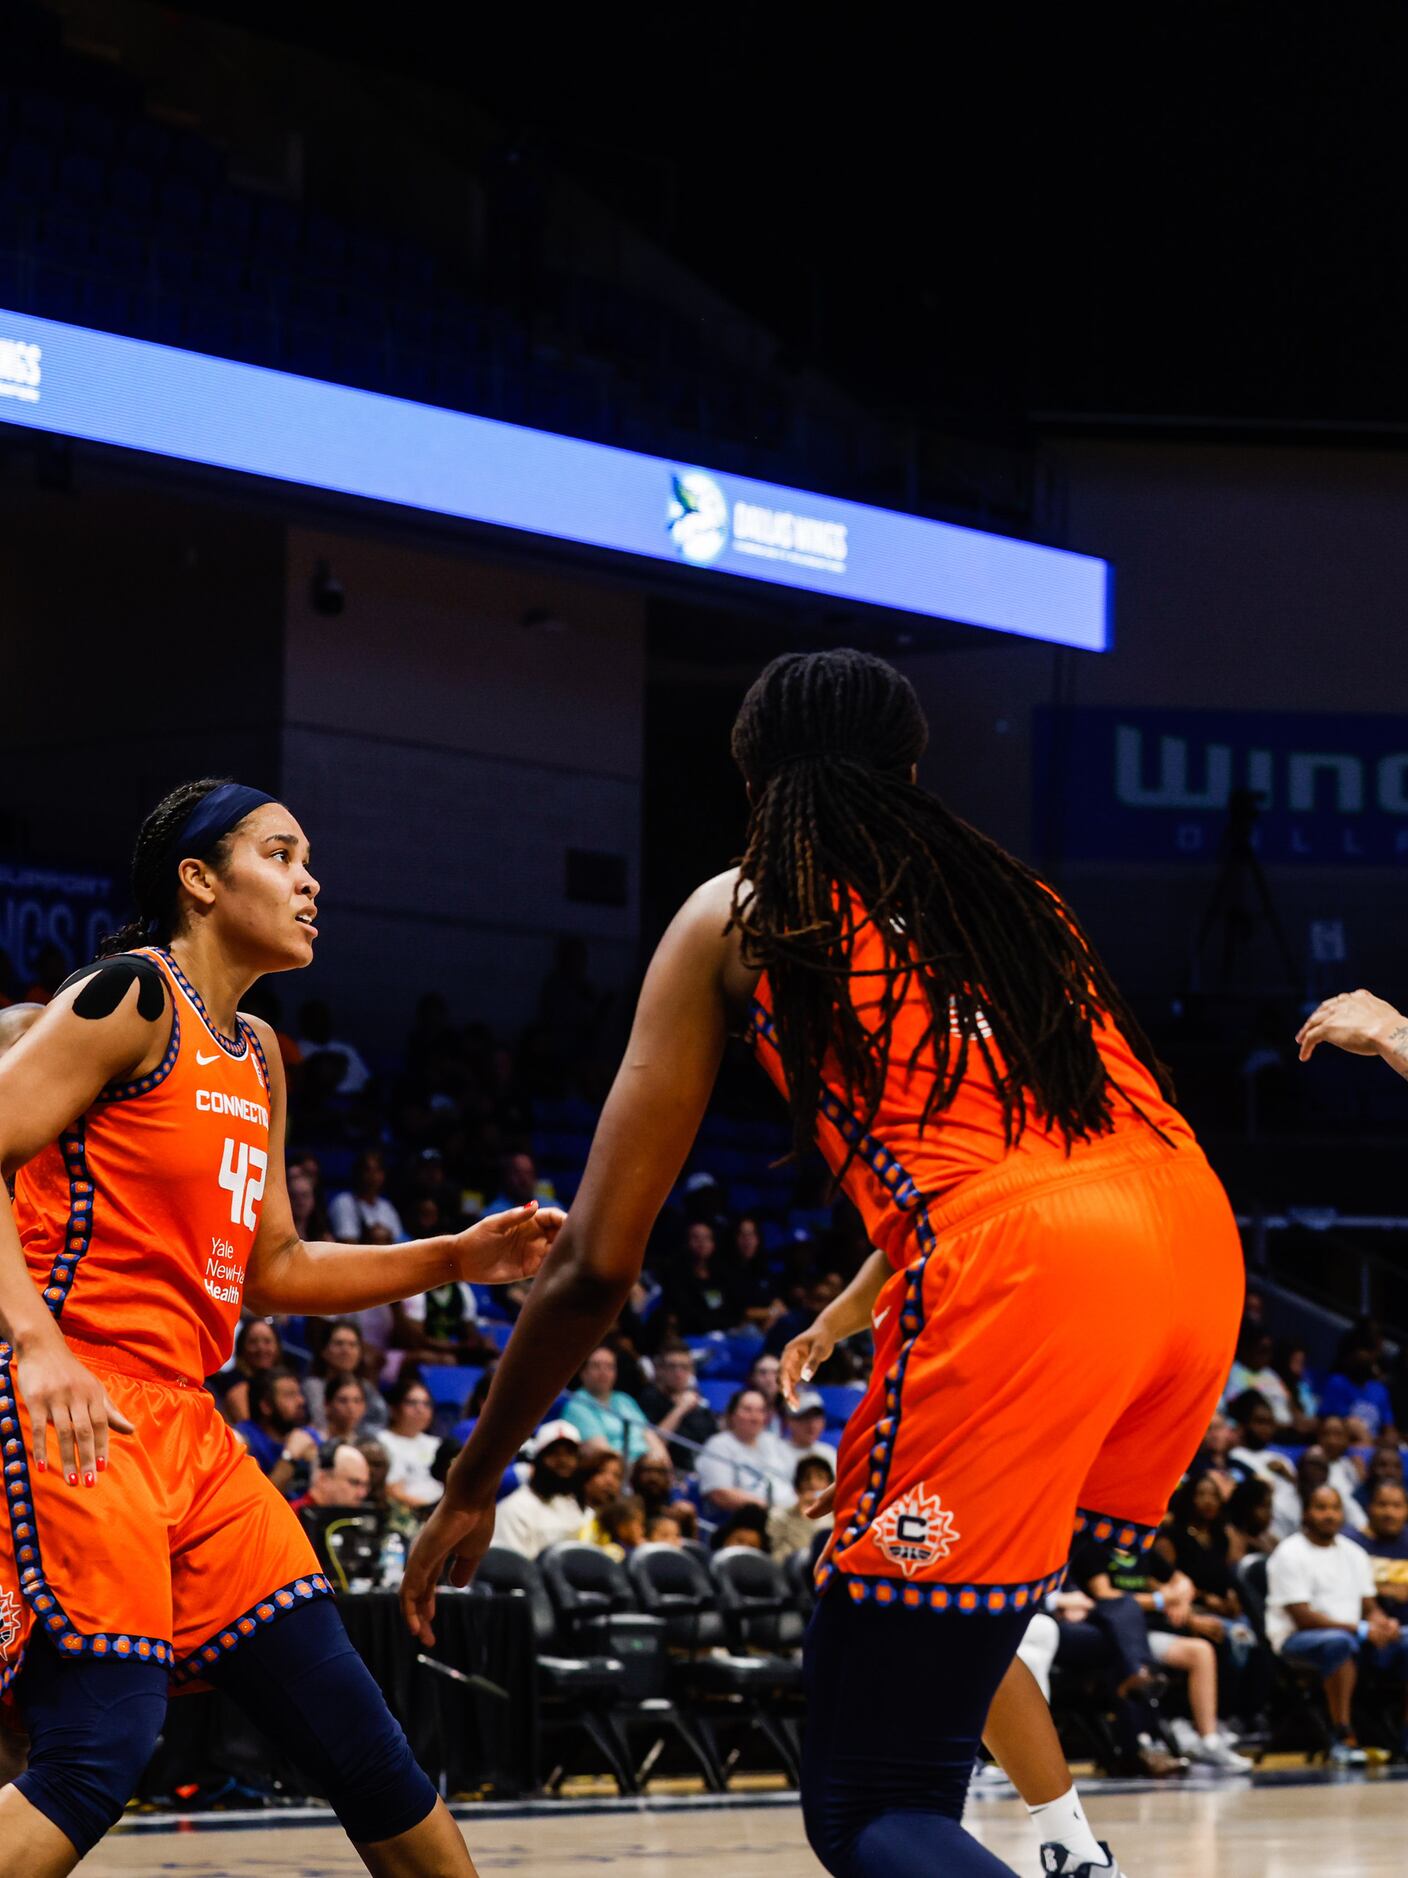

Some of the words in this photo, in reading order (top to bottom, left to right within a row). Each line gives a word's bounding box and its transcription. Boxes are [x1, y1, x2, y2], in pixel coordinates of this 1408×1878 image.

[218, 1137, 268, 1232] 42
[212, 1237, 234, 1259] Yale
[204, 1278, 239, 1305] Health
